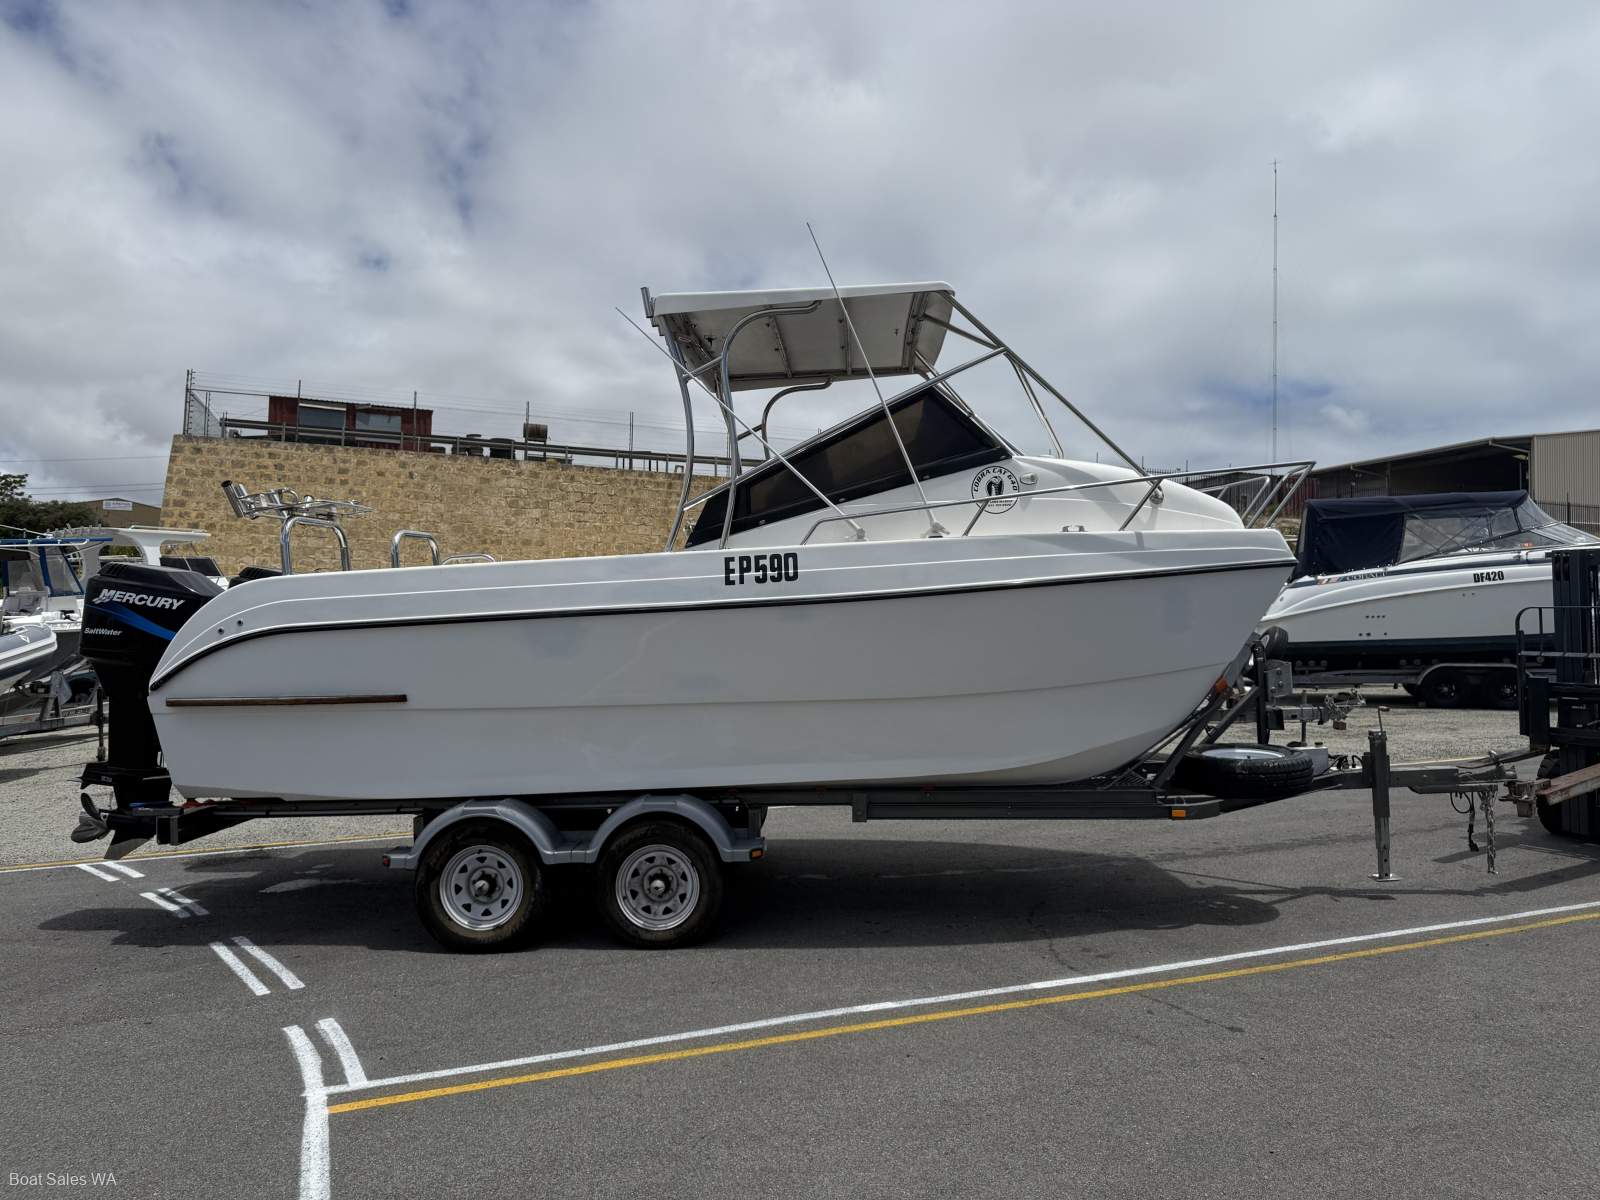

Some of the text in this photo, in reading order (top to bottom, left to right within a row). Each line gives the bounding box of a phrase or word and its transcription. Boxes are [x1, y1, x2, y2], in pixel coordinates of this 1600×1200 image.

[974, 469, 991, 492] COBRA
[1007, 474, 1018, 491] 640
[724, 552, 799, 586] EP590
[1473, 570, 1505, 583] DF420
[93, 588, 186, 610] MERCURY
[84, 627, 122, 636] SaltWater
